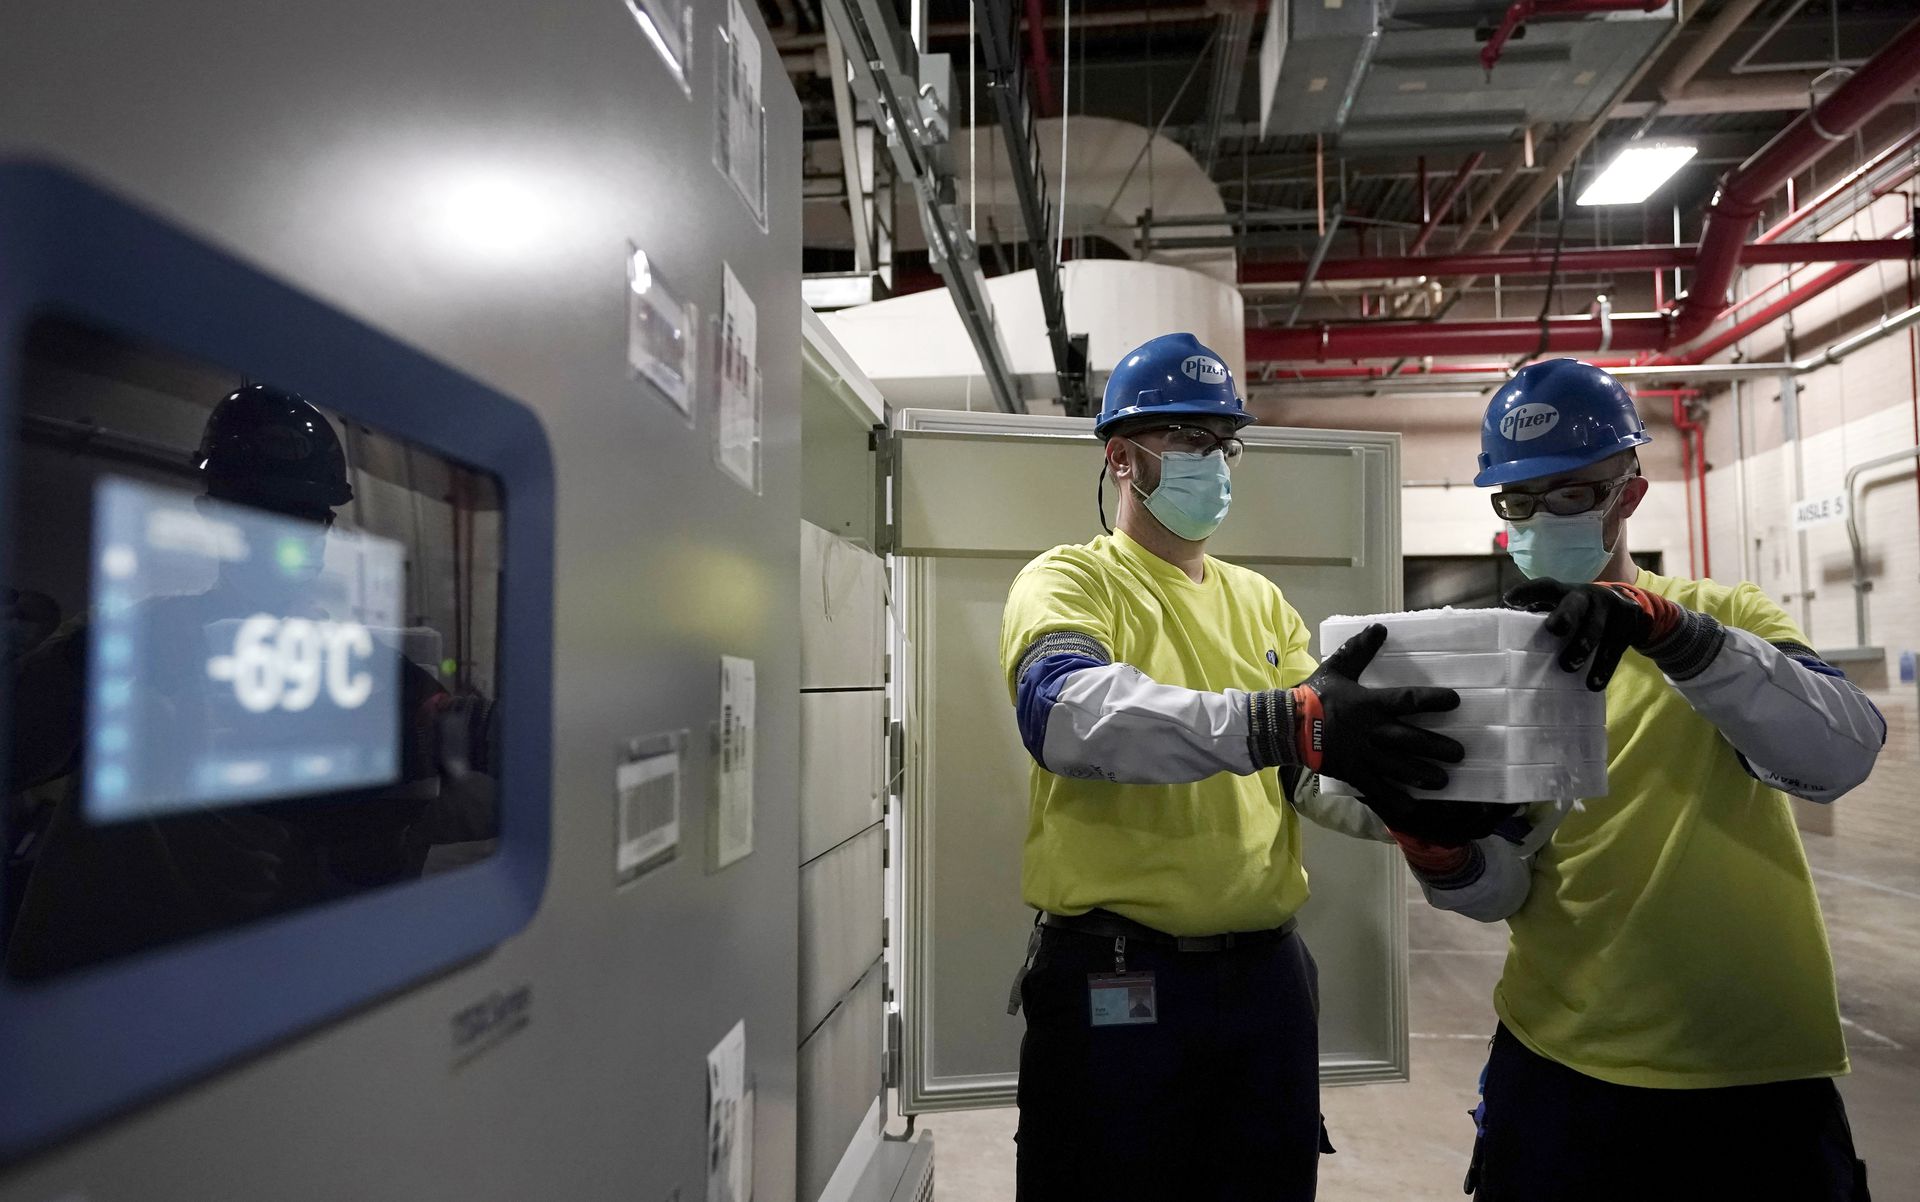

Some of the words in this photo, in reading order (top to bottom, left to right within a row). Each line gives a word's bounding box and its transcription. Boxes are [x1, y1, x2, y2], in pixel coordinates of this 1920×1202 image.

[1185, 358, 1226, 382] Pfizer
[1503, 408, 1558, 441] Pfizer
[1797, 499, 1831, 522] AISLE
[1313, 720, 1323, 751] ULINE
